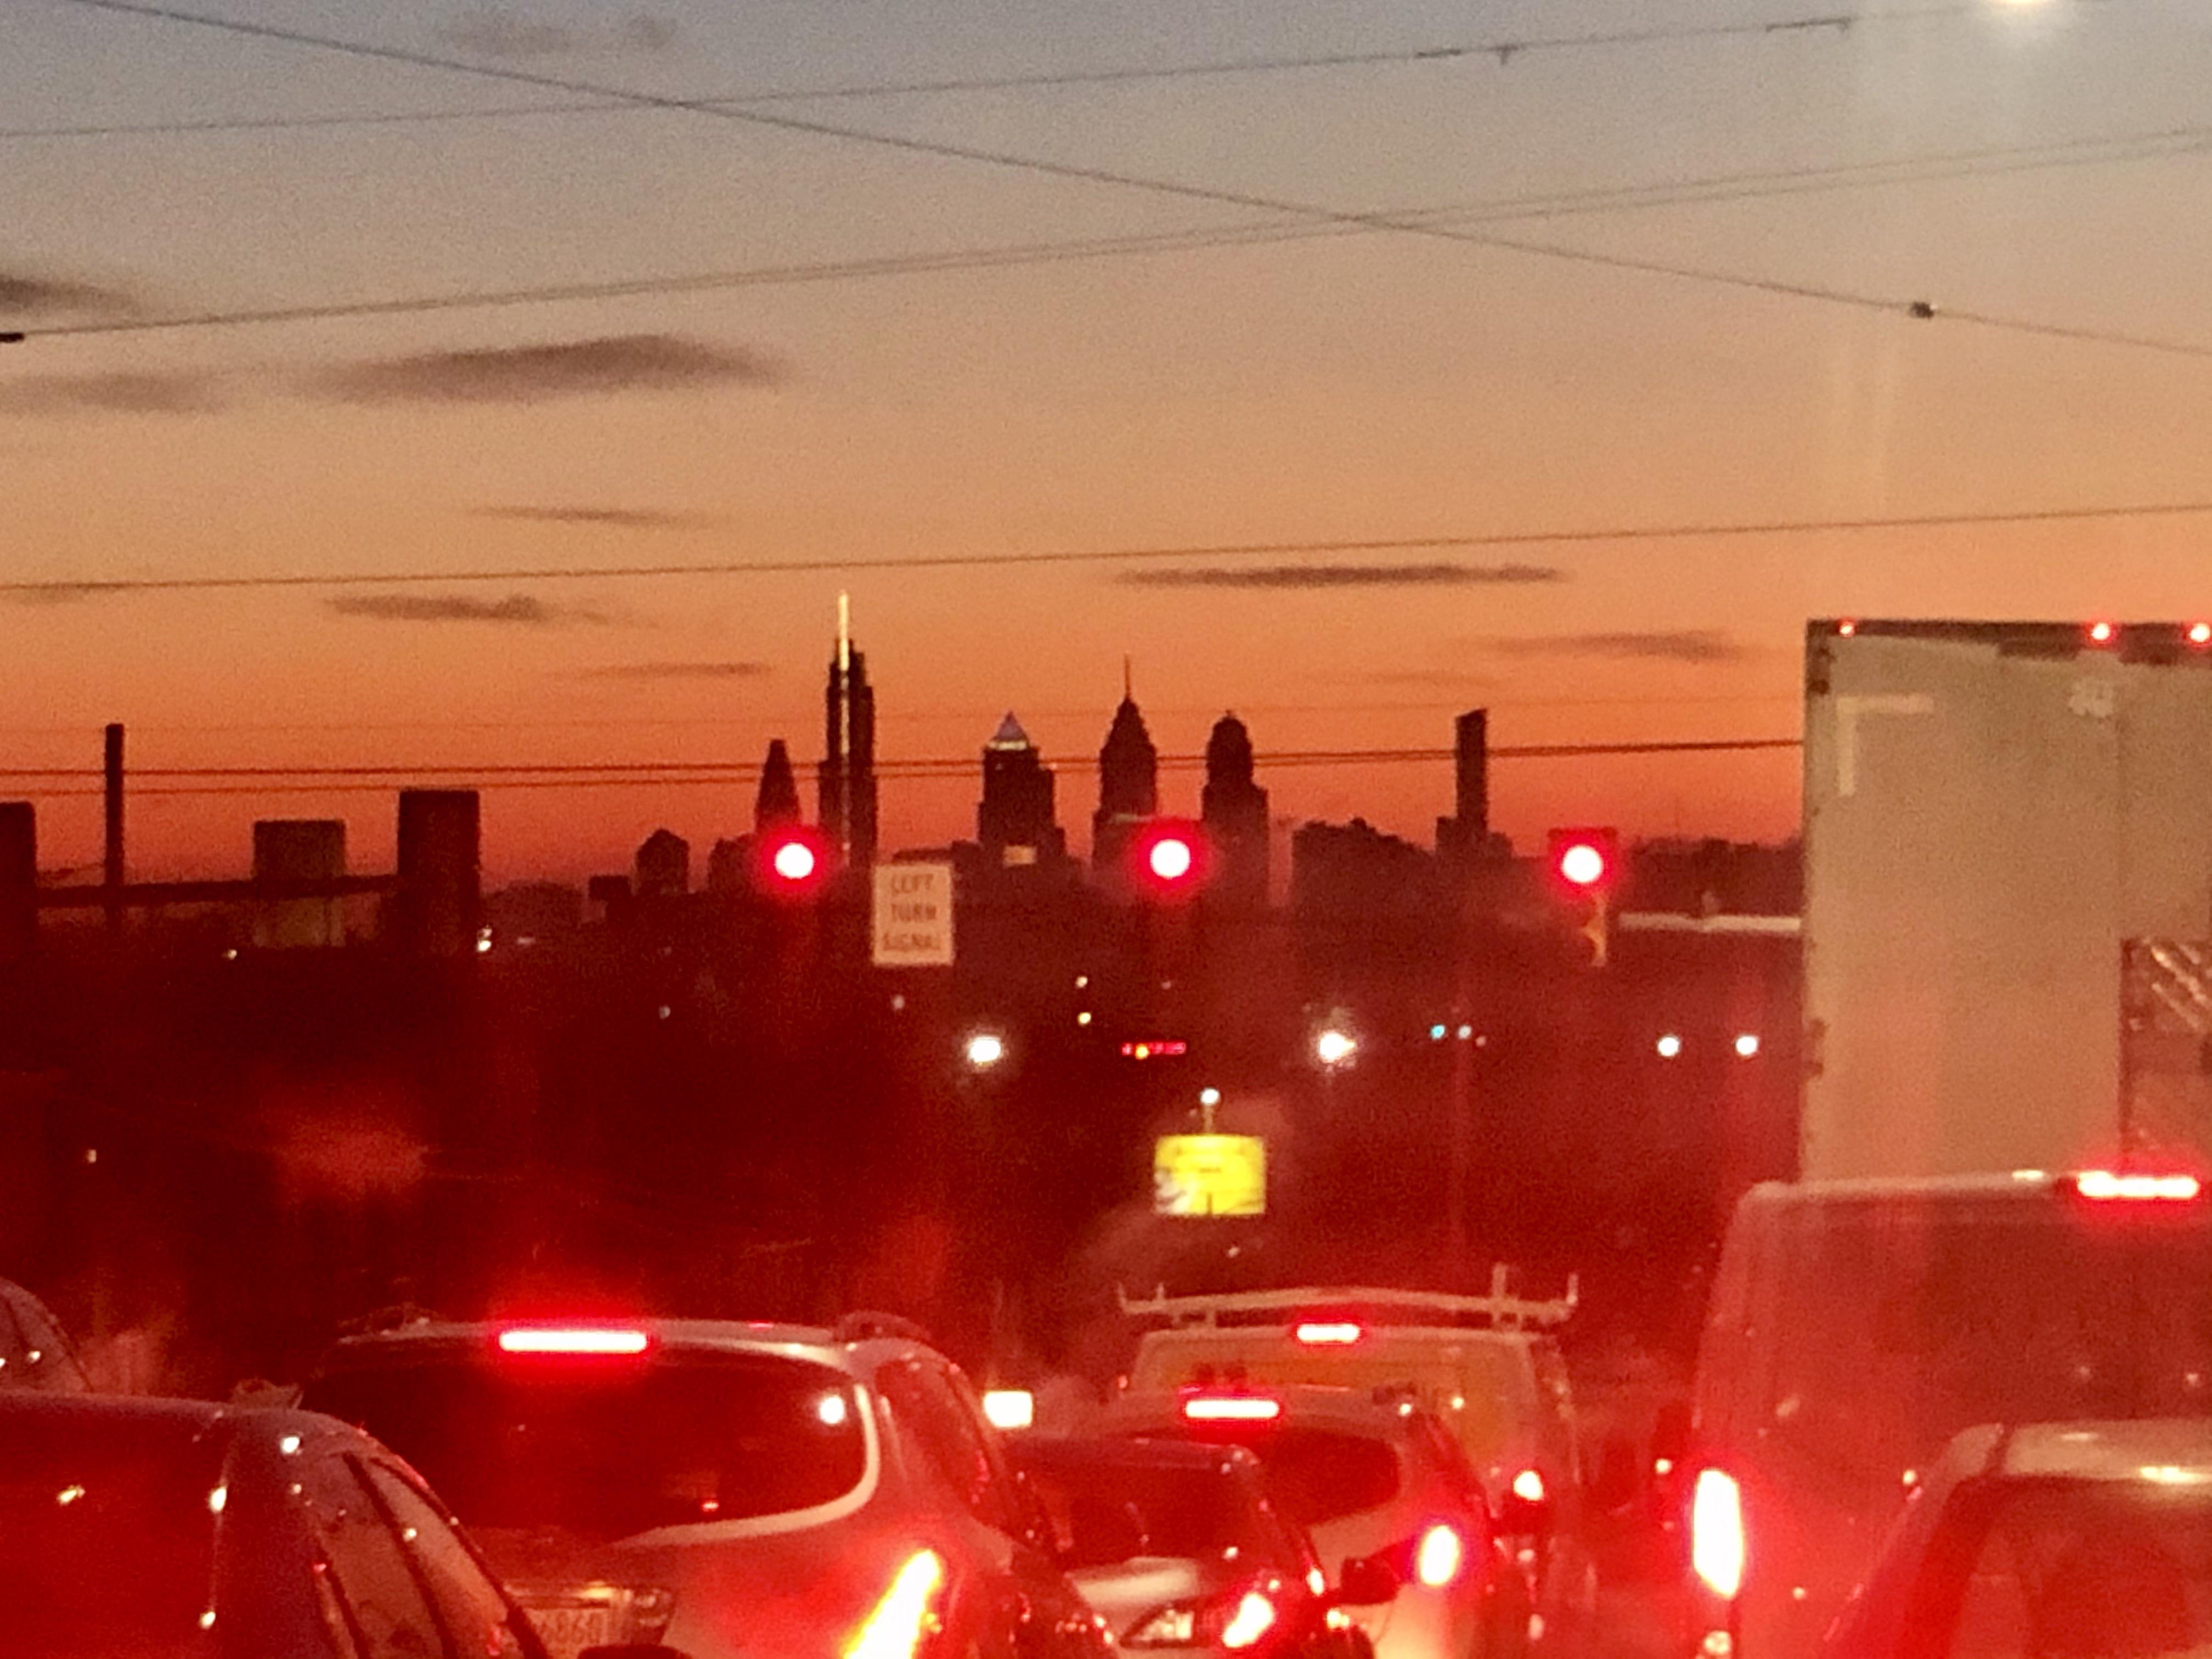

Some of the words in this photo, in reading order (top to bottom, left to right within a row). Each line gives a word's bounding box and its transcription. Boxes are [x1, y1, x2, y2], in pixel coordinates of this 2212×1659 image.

[891, 873, 934, 894] LEFT
[891, 904, 937, 923] TURN
[883, 932, 942, 952] SIGNAL
